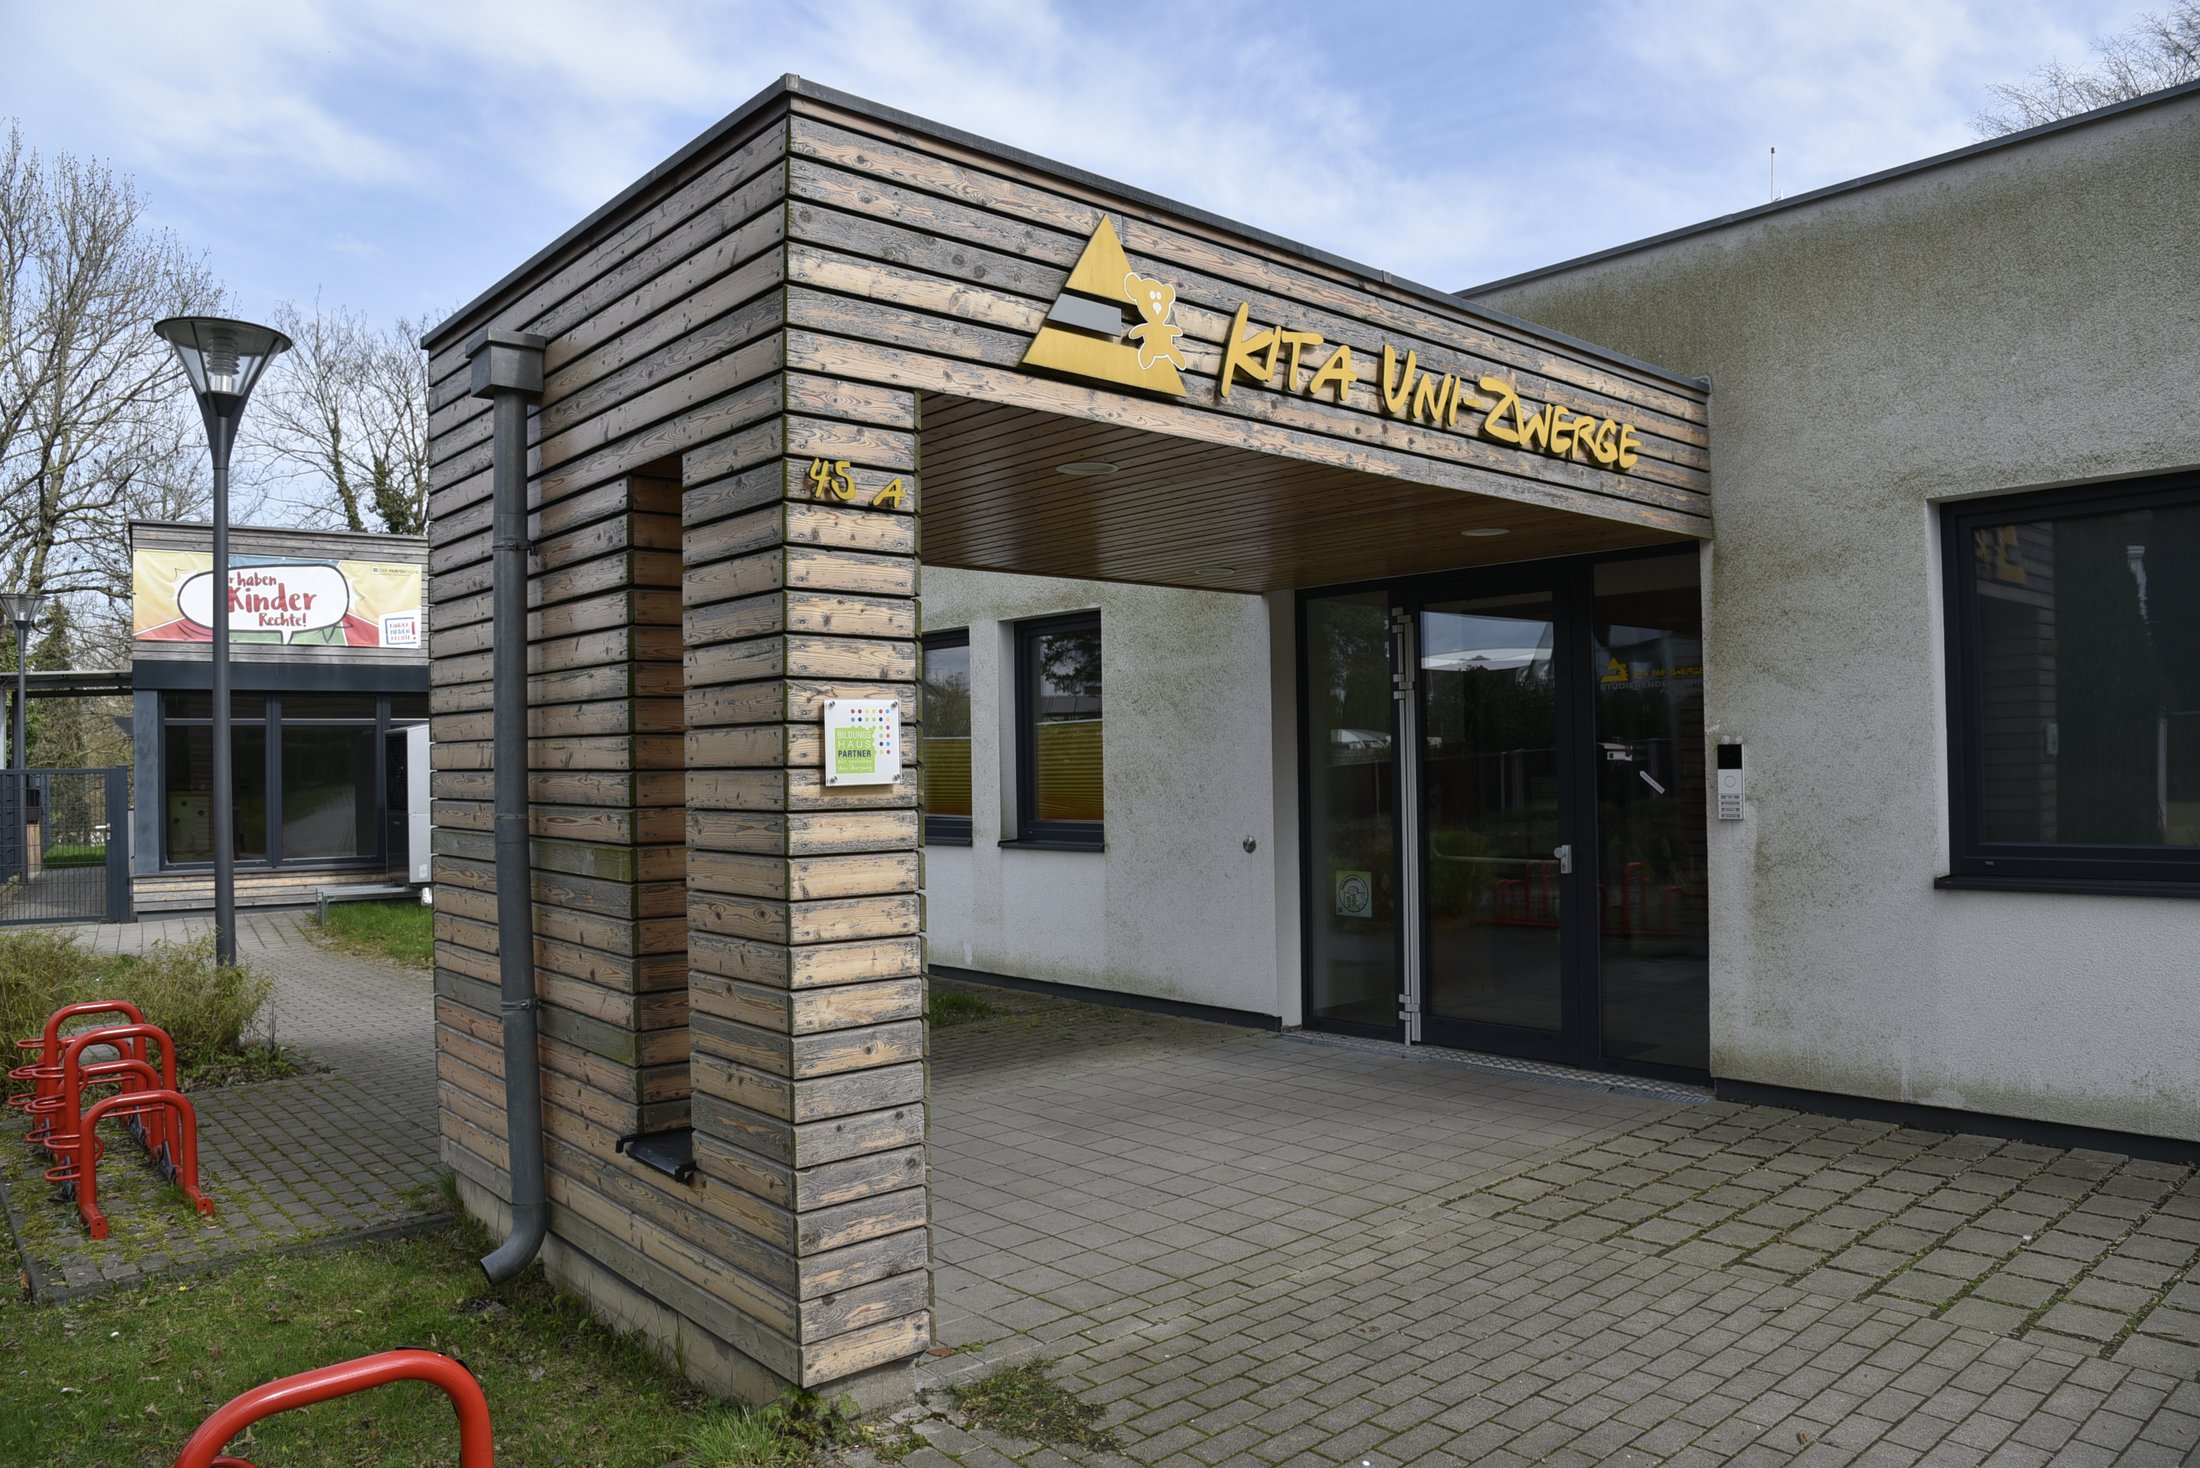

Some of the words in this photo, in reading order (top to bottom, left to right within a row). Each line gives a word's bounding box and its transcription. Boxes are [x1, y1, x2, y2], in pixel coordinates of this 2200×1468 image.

[1220, 301, 1358, 400] KITA
[1382, 343, 1642, 471] UNI-ZWERGE
[809, 457, 857, 501] 45
[873, 477, 907, 509] A
[237, 571, 277, 587] haben
[228, 582, 318, 613] Kinder
[258, 612, 307, 627] Rechte!
[837, 730, 871, 739] BILDUNGS
[837, 740, 872, 748] HAUS
[838, 749, 872, 758] PARTNER
